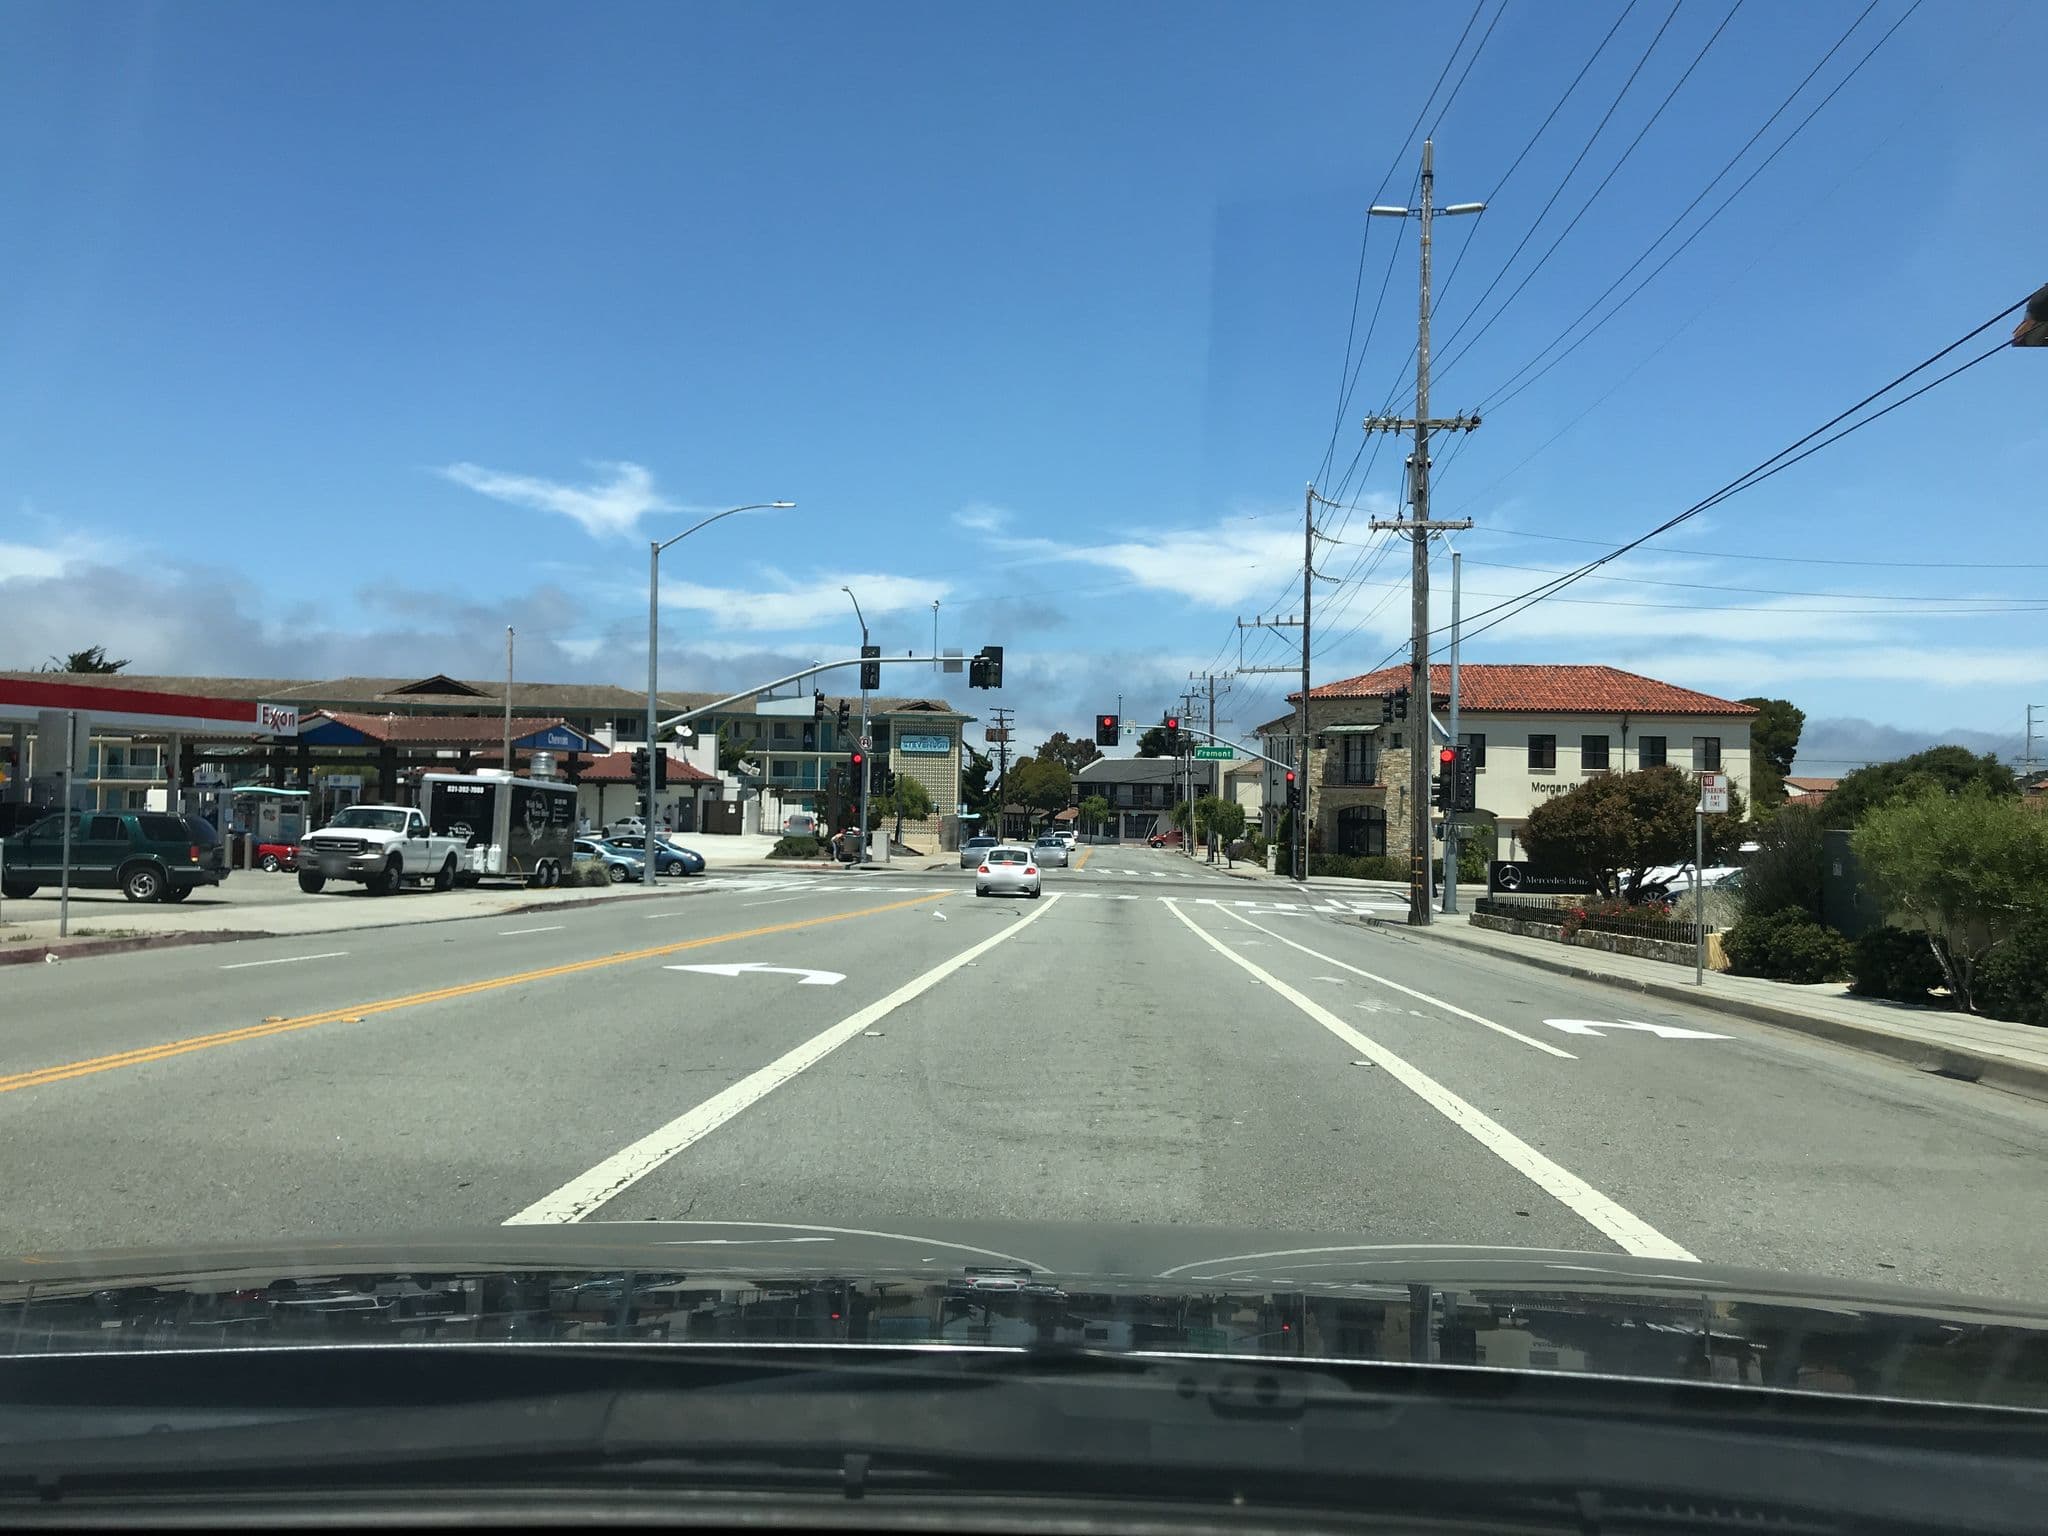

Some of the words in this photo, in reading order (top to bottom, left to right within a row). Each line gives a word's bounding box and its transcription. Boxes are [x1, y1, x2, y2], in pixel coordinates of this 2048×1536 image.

[261, 704, 295, 732] Exxon
[1197, 749, 1231, 758] Fremont
[1703, 776, 1714, 786] NO
[1531, 782, 1568, 795] Morgan
